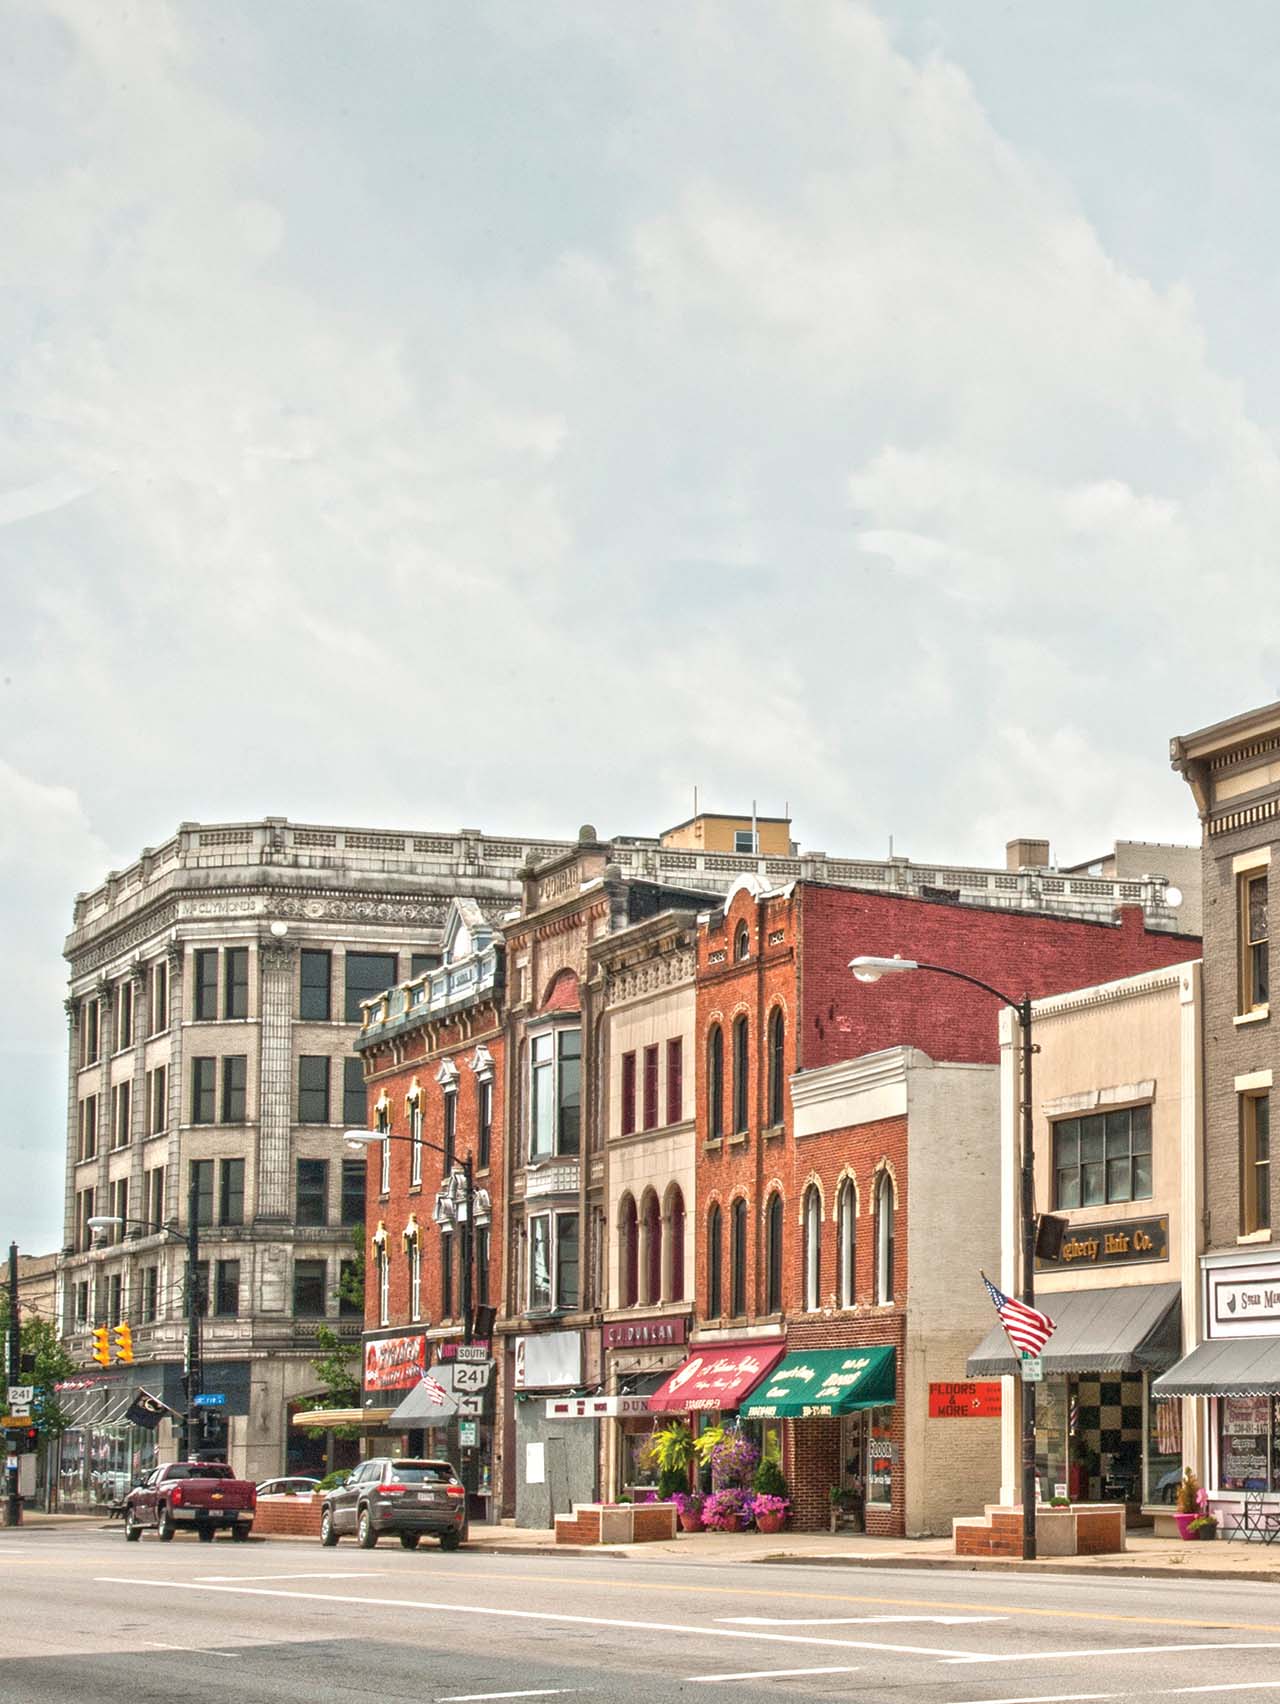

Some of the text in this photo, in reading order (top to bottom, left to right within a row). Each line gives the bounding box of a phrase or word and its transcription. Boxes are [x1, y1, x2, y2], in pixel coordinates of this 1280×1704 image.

[1062, 1229, 1153, 1262] gherty Hair Co.
[459, 1348, 485, 1358] SOUTH
[457, 1370, 484, 1384] 241
[11, 1389, 30, 1400] 241
[929, 1383, 976, 1395] FLOORS
[622, 1400, 648, 1411] DUN
[949, 1395, 956, 1405] &
[938, 1405, 968, 1417] MORE
